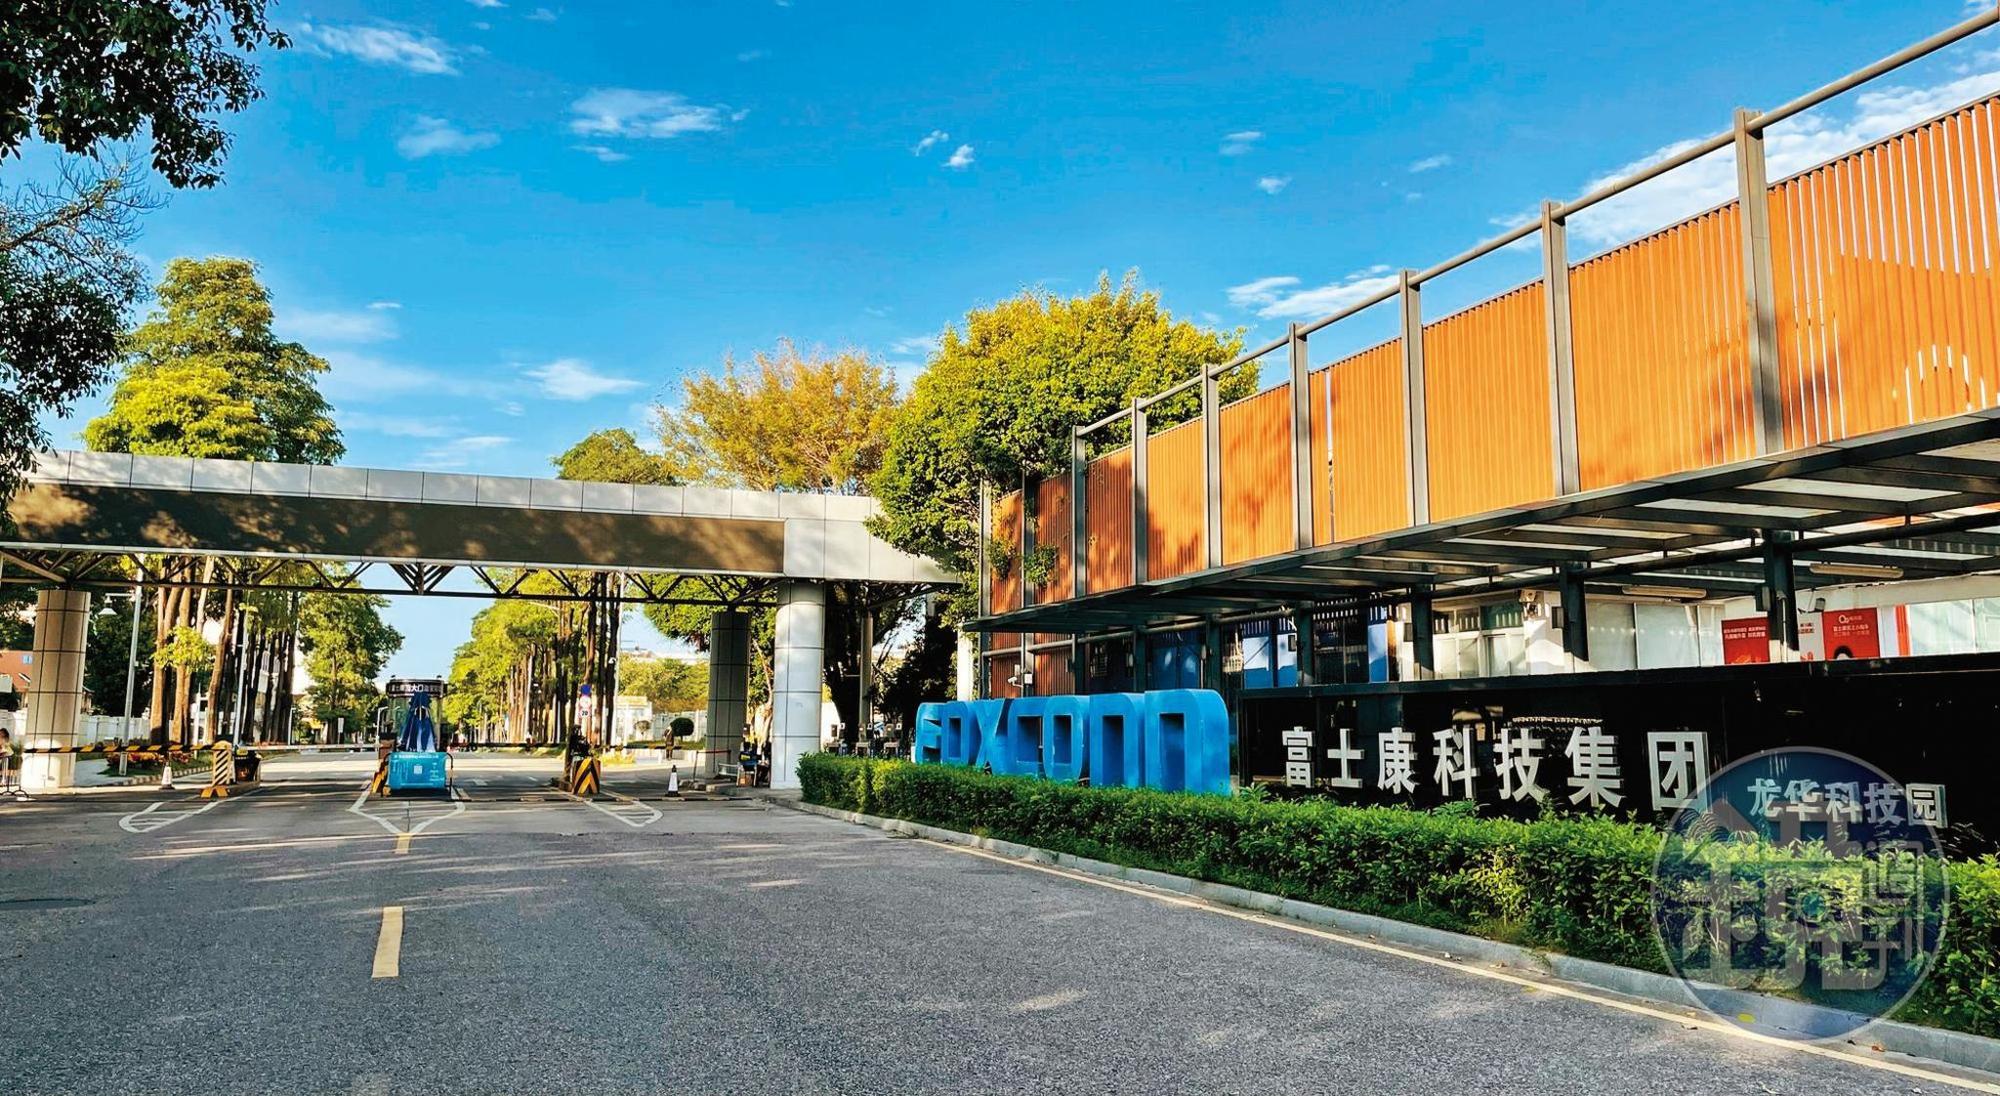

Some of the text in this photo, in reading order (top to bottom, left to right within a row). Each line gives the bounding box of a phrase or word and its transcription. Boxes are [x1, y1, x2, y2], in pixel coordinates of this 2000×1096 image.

[1281, 725, 1712, 815] 富士康科技集团
[1747, 777, 1948, 829] 龙华科技园
